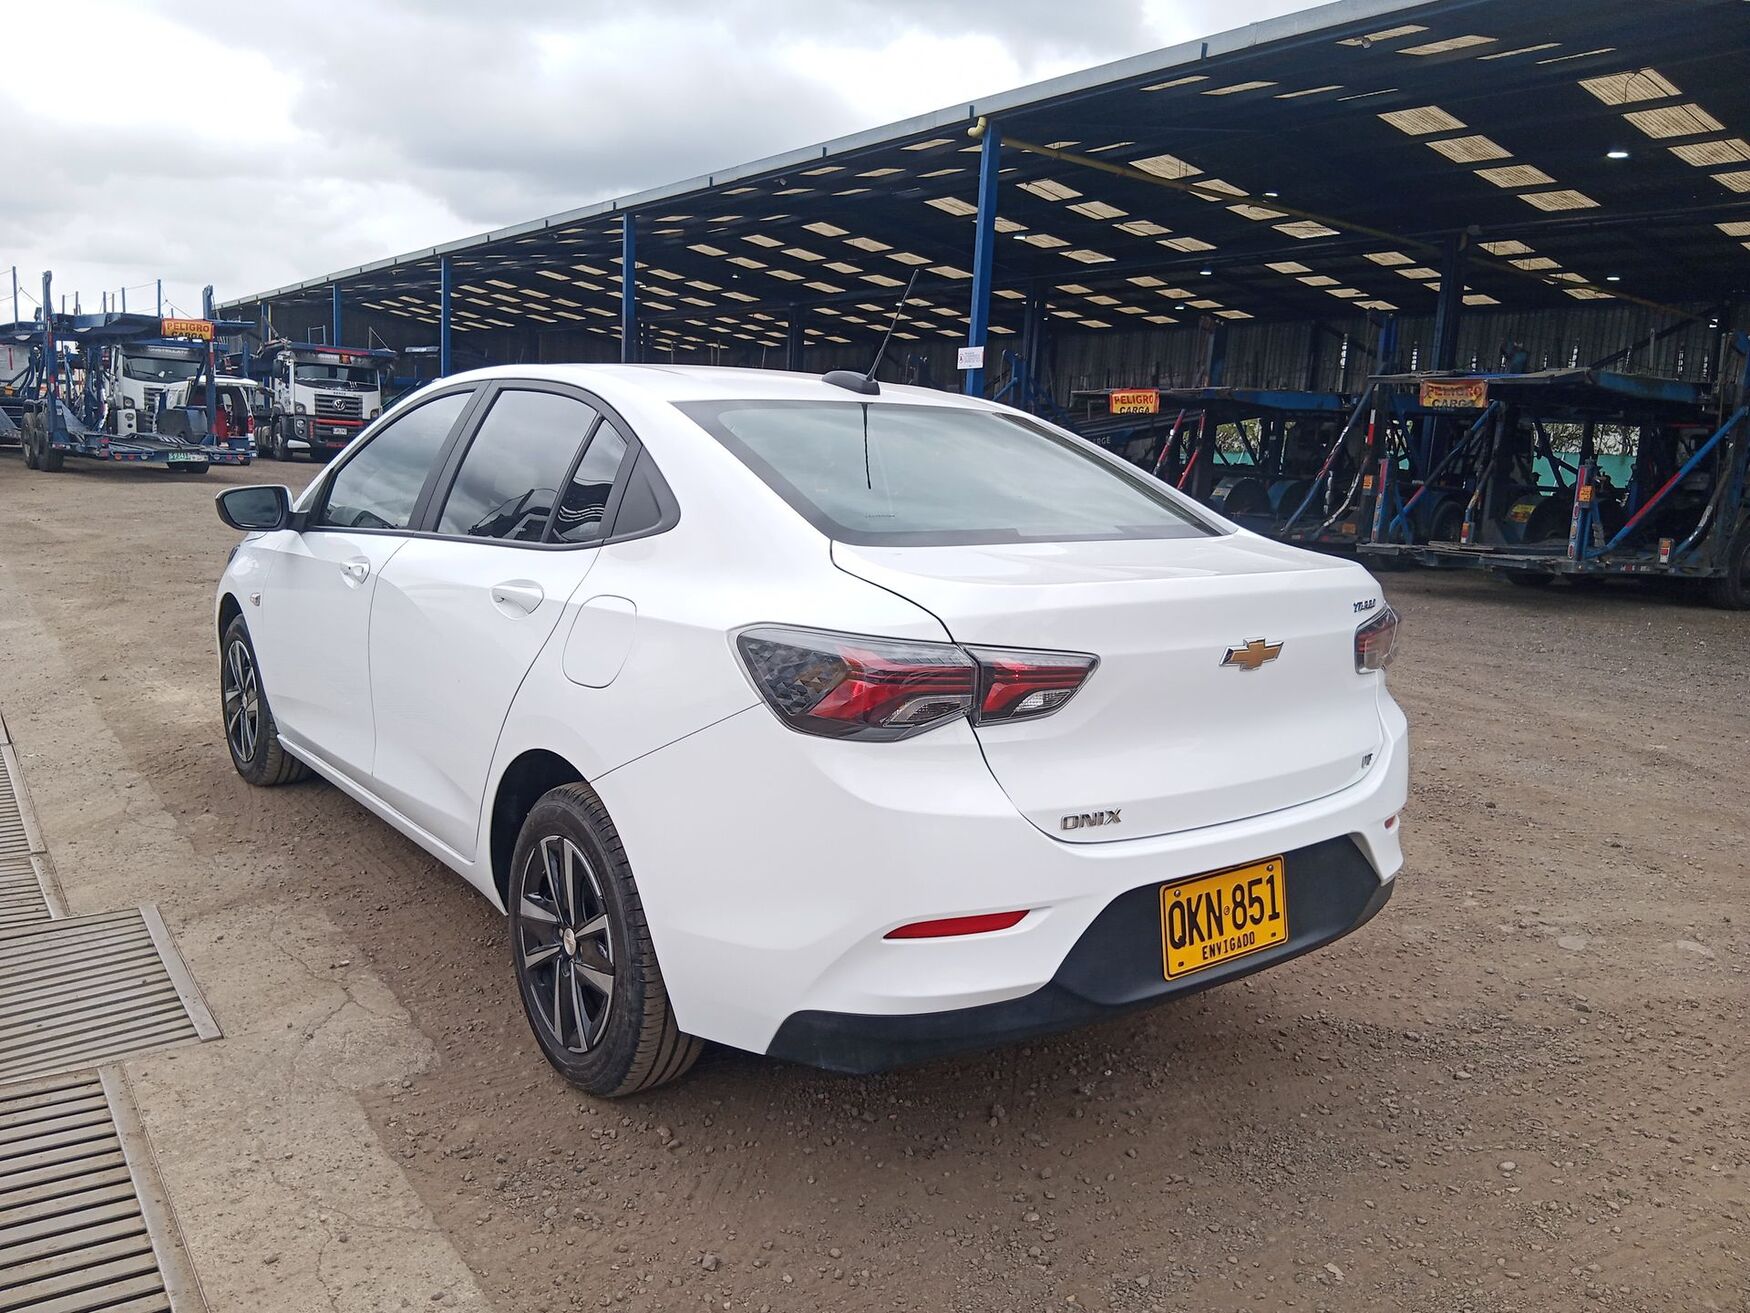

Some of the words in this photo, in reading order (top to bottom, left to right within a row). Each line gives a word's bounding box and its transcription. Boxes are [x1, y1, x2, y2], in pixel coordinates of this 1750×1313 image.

[167, 322, 210, 333] PELIGRO
[1114, 394, 1154, 405] PELIGRO
[1119, 406, 1151, 415] CARGA
[1061, 808, 1122, 831] ONIX
[1201, 931, 1255, 960] ENVIGADO
